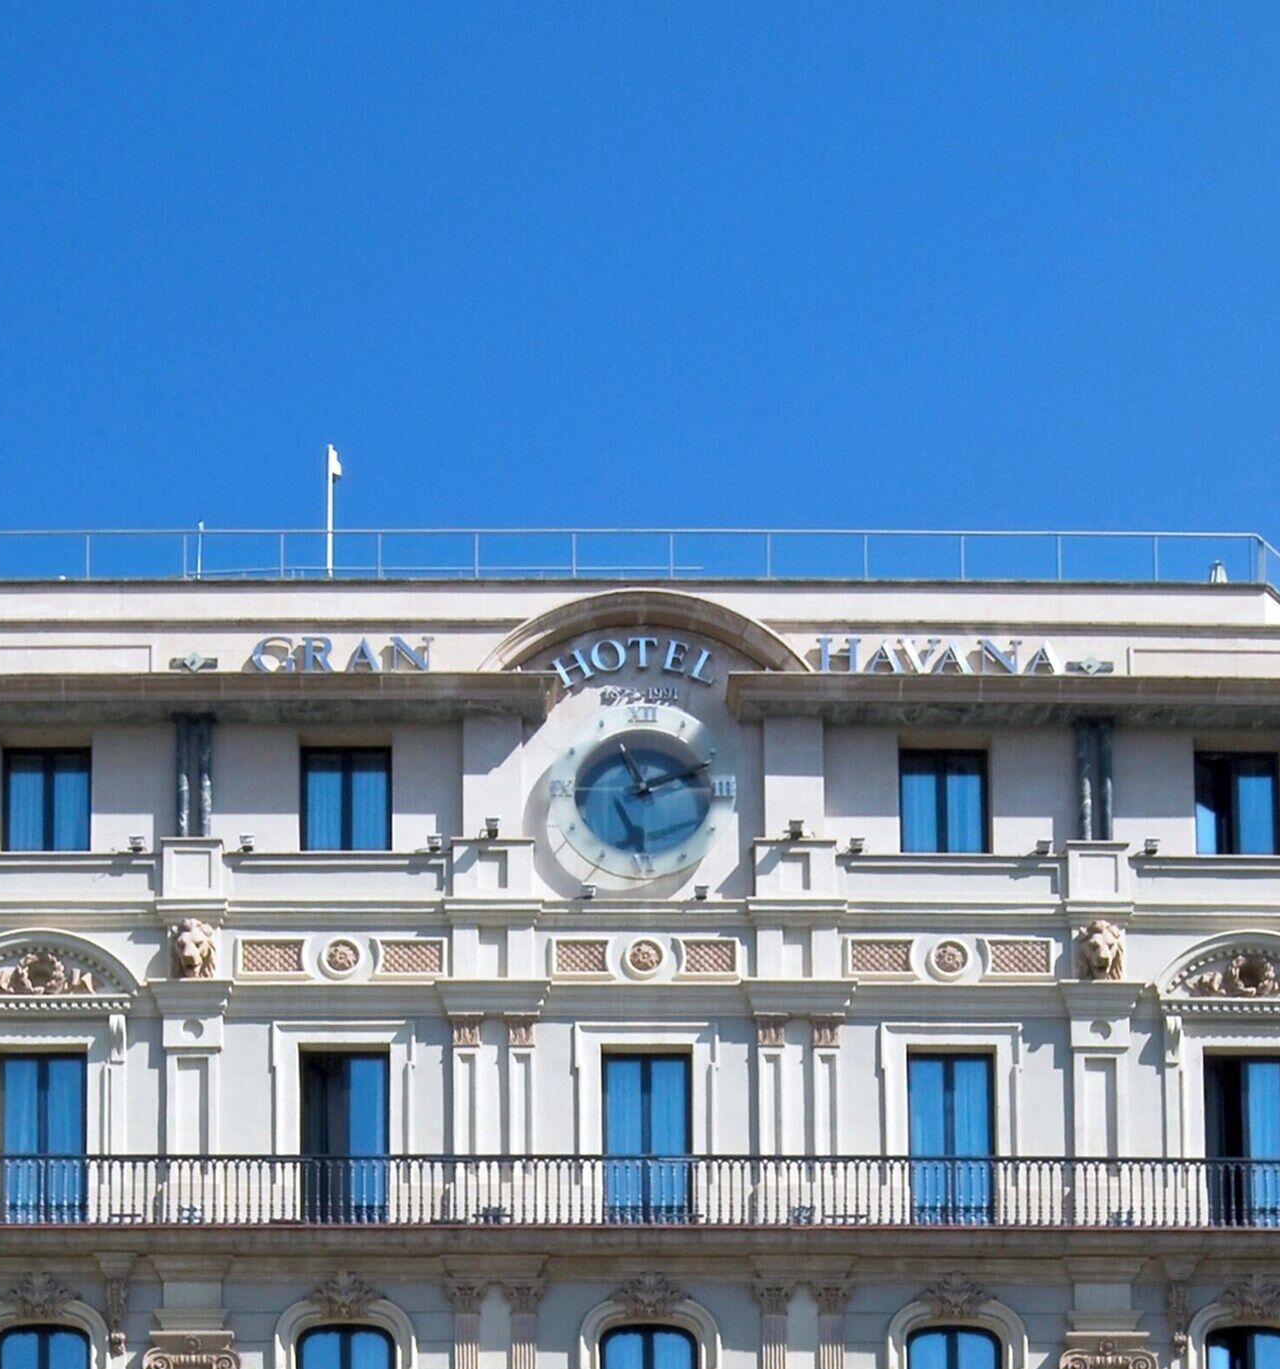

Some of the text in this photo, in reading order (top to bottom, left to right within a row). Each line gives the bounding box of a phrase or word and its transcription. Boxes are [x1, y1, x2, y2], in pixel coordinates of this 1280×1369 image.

[251, 636, 1066, 689] GRAN HOTEL HAVANA
[648, 687, 679, 700] 1991
